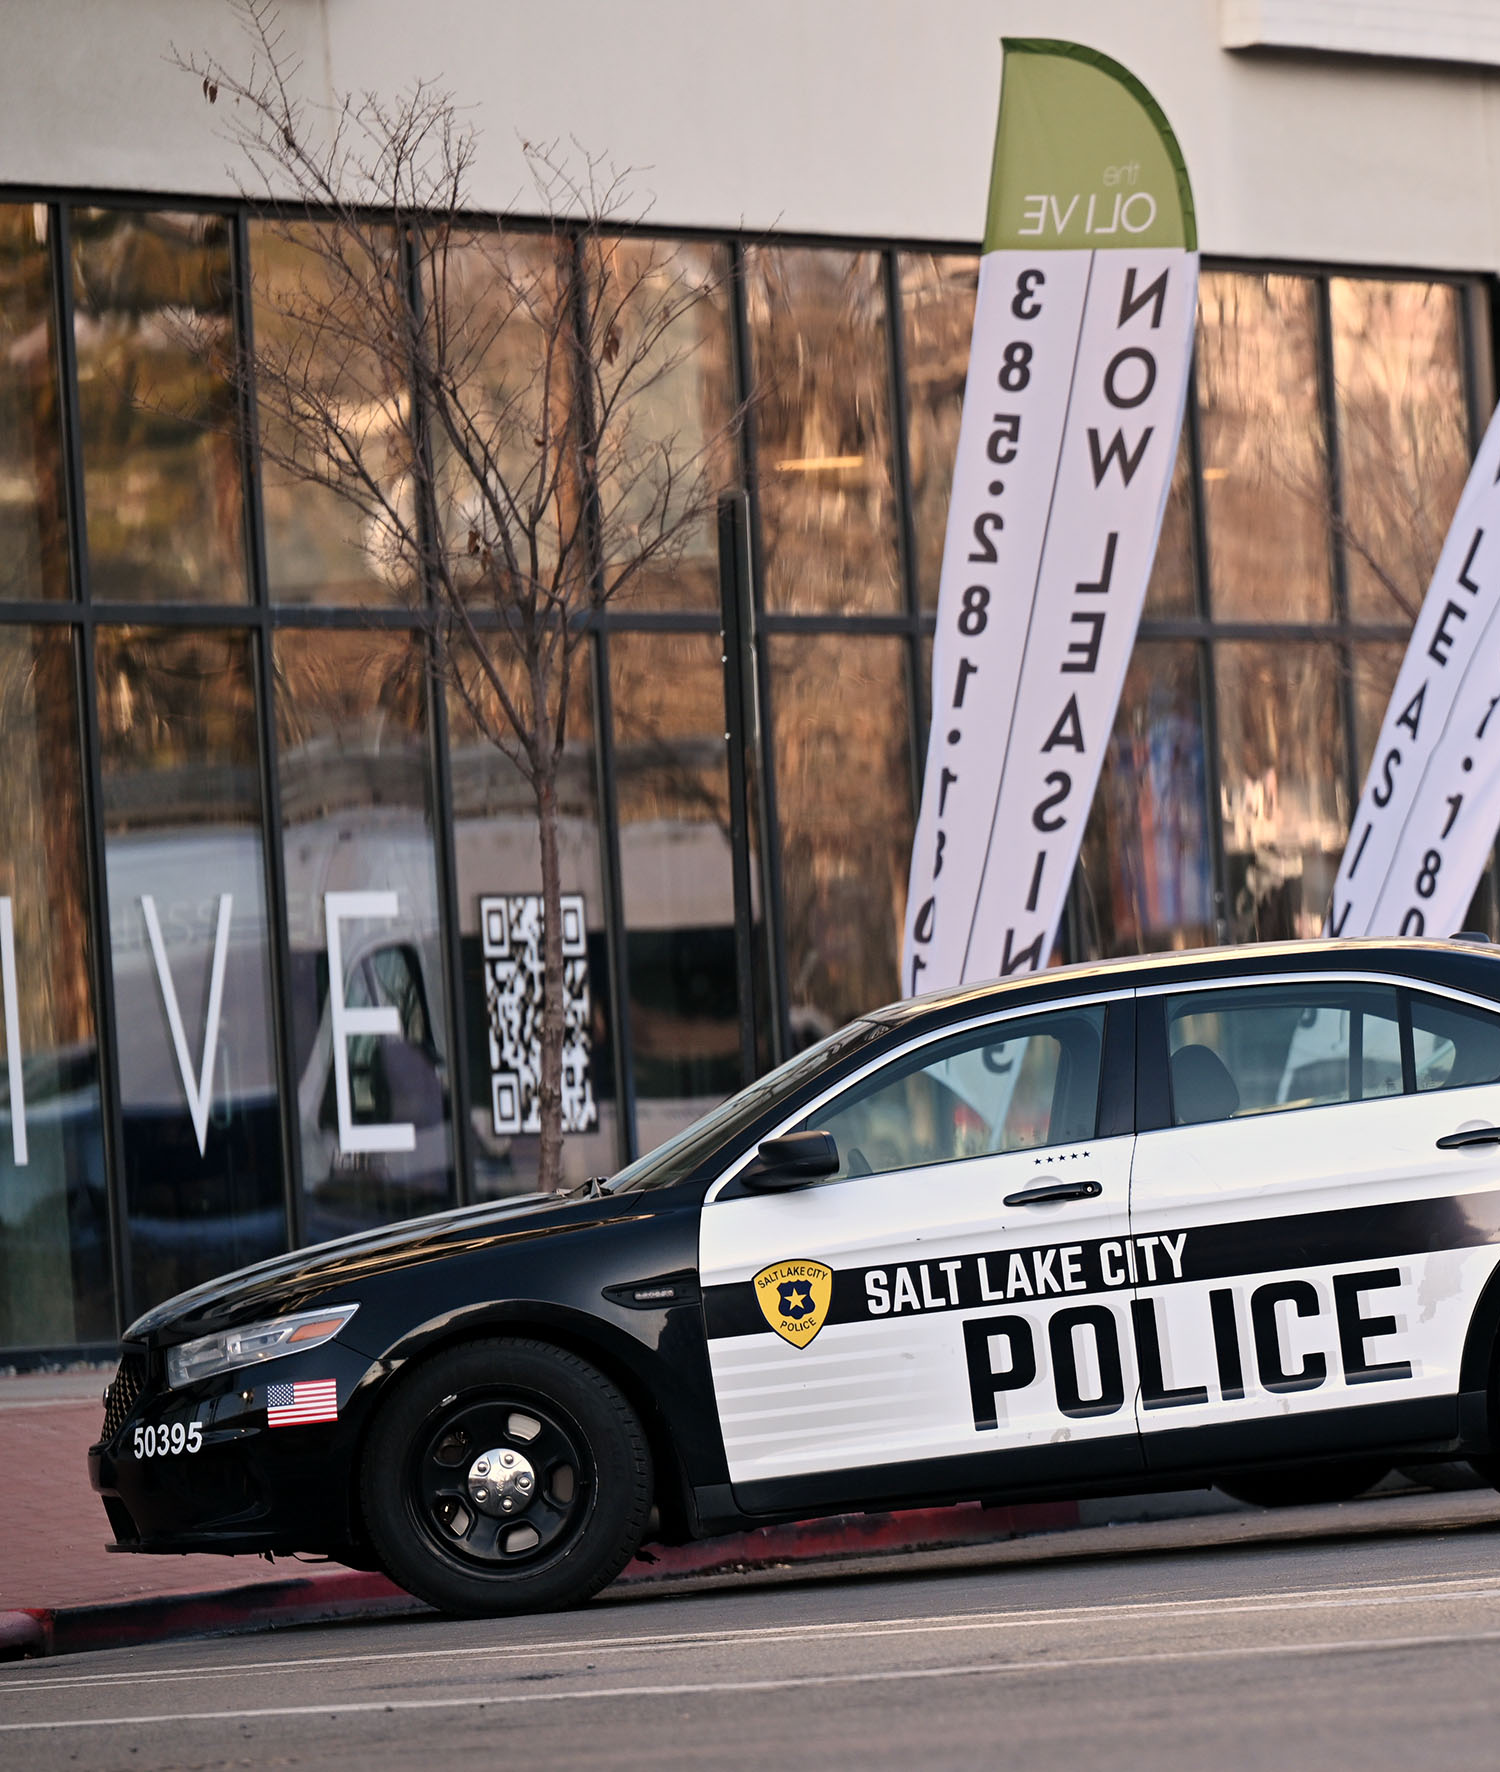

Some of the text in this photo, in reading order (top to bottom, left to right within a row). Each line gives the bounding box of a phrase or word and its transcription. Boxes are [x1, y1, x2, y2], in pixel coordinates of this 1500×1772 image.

[757, 1266, 829, 1289] SALT LAKE CITY
[864, 1232, 1188, 1315] SALT LAKE CITY
[779, 1317, 817, 1332] POLICE
[961, 1267, 1413, 1432] POLICE
[133, 1421, 203, 1460] 50395
